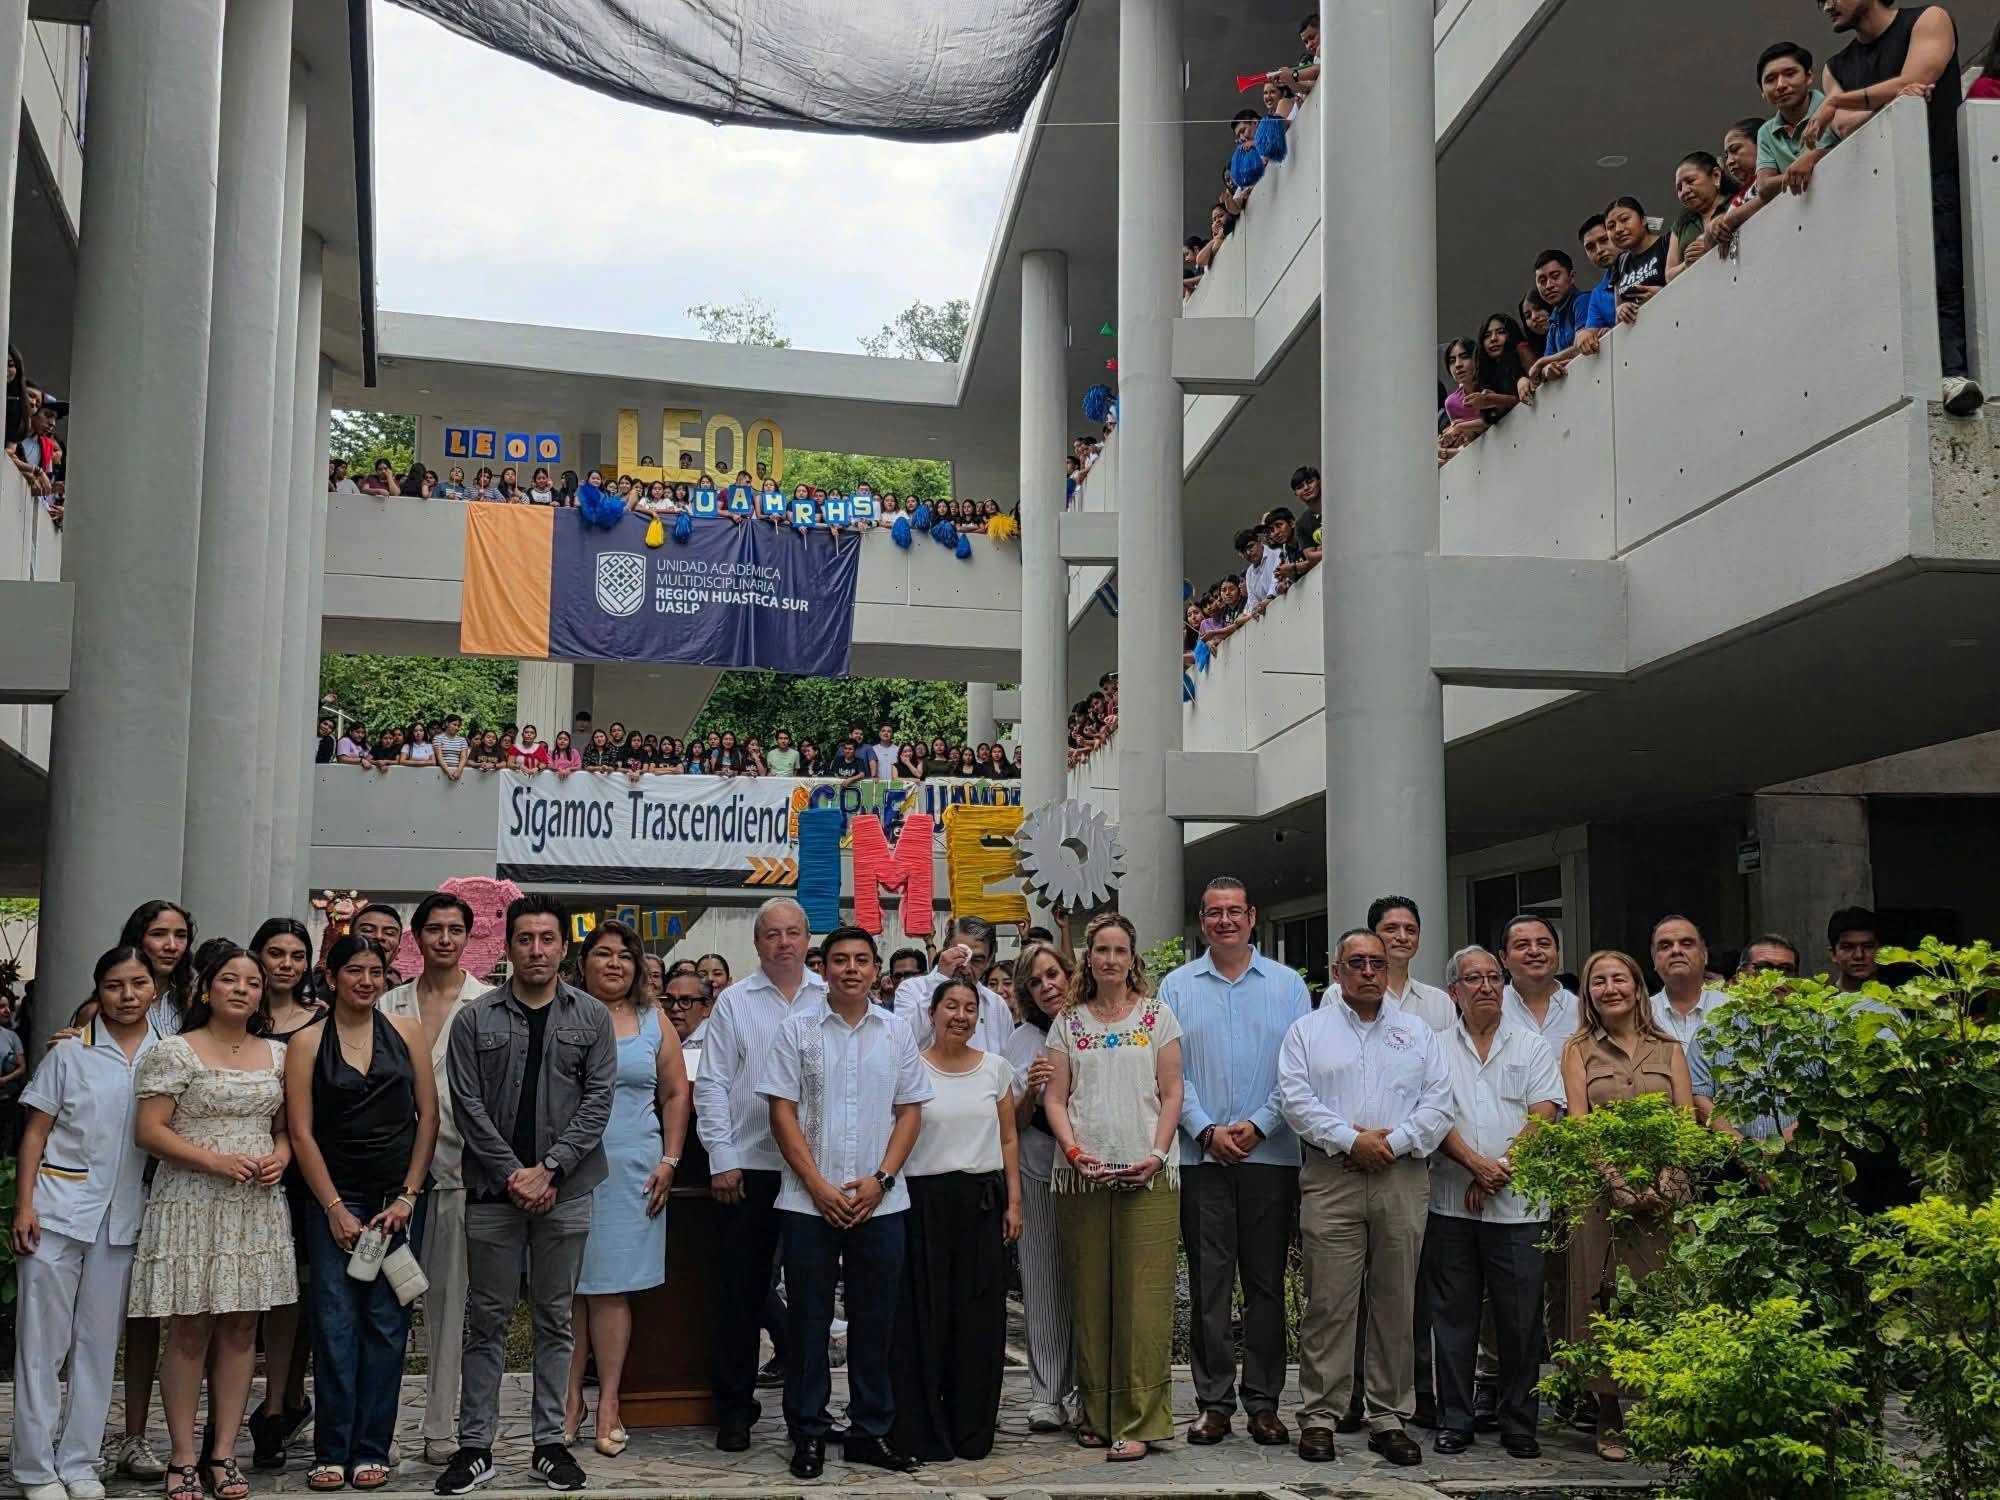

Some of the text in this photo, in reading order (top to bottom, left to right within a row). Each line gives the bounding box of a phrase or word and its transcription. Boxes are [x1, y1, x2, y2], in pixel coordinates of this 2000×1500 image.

[450, 431, 557, 459] LEOO
[617, 408, 784, 489] LEOO
[696, 488, 872, 524] UAMRHS
[656, 574, 776, 594] MULTIDISCIPLINARIA
[657, 560, 781, 580] UNIDAD ACADÉMICA
[655, 600, 700, 615] UASLP
[656, 587, 809, 612] REGIÓN HUASTECA SUR
[510, 786, 790, 853] Sigamos Trascendiend
[797, 805, 1029, 936] IME
